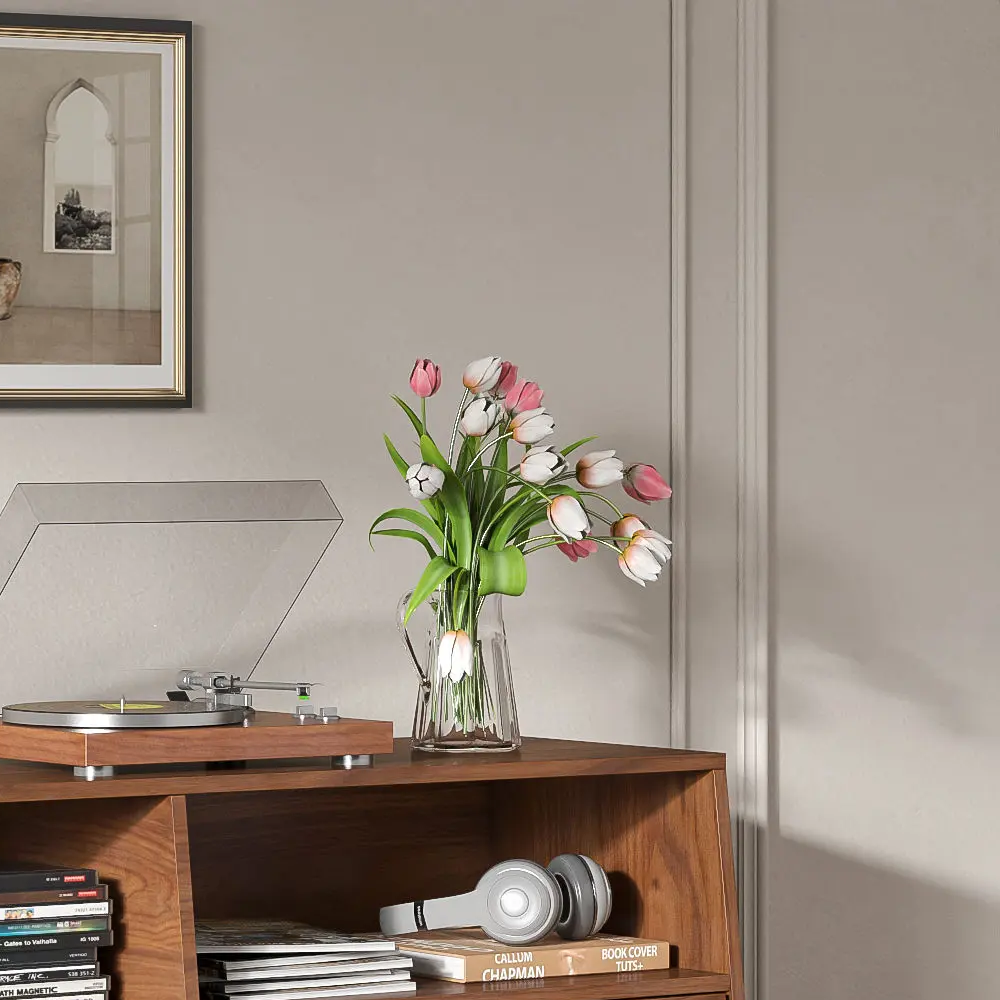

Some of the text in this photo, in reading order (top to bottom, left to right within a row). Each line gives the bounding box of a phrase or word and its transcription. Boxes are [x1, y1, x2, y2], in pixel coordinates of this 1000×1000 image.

[495, 952, 532, 964] CALLUM
[602, 946, 657, 960] BOOK COVER
[615, 960, 643, 972] TUTS+
[482, 966, 544, 982] CHAPMAN
[17, 986, 58, 996] MAGNETIC
